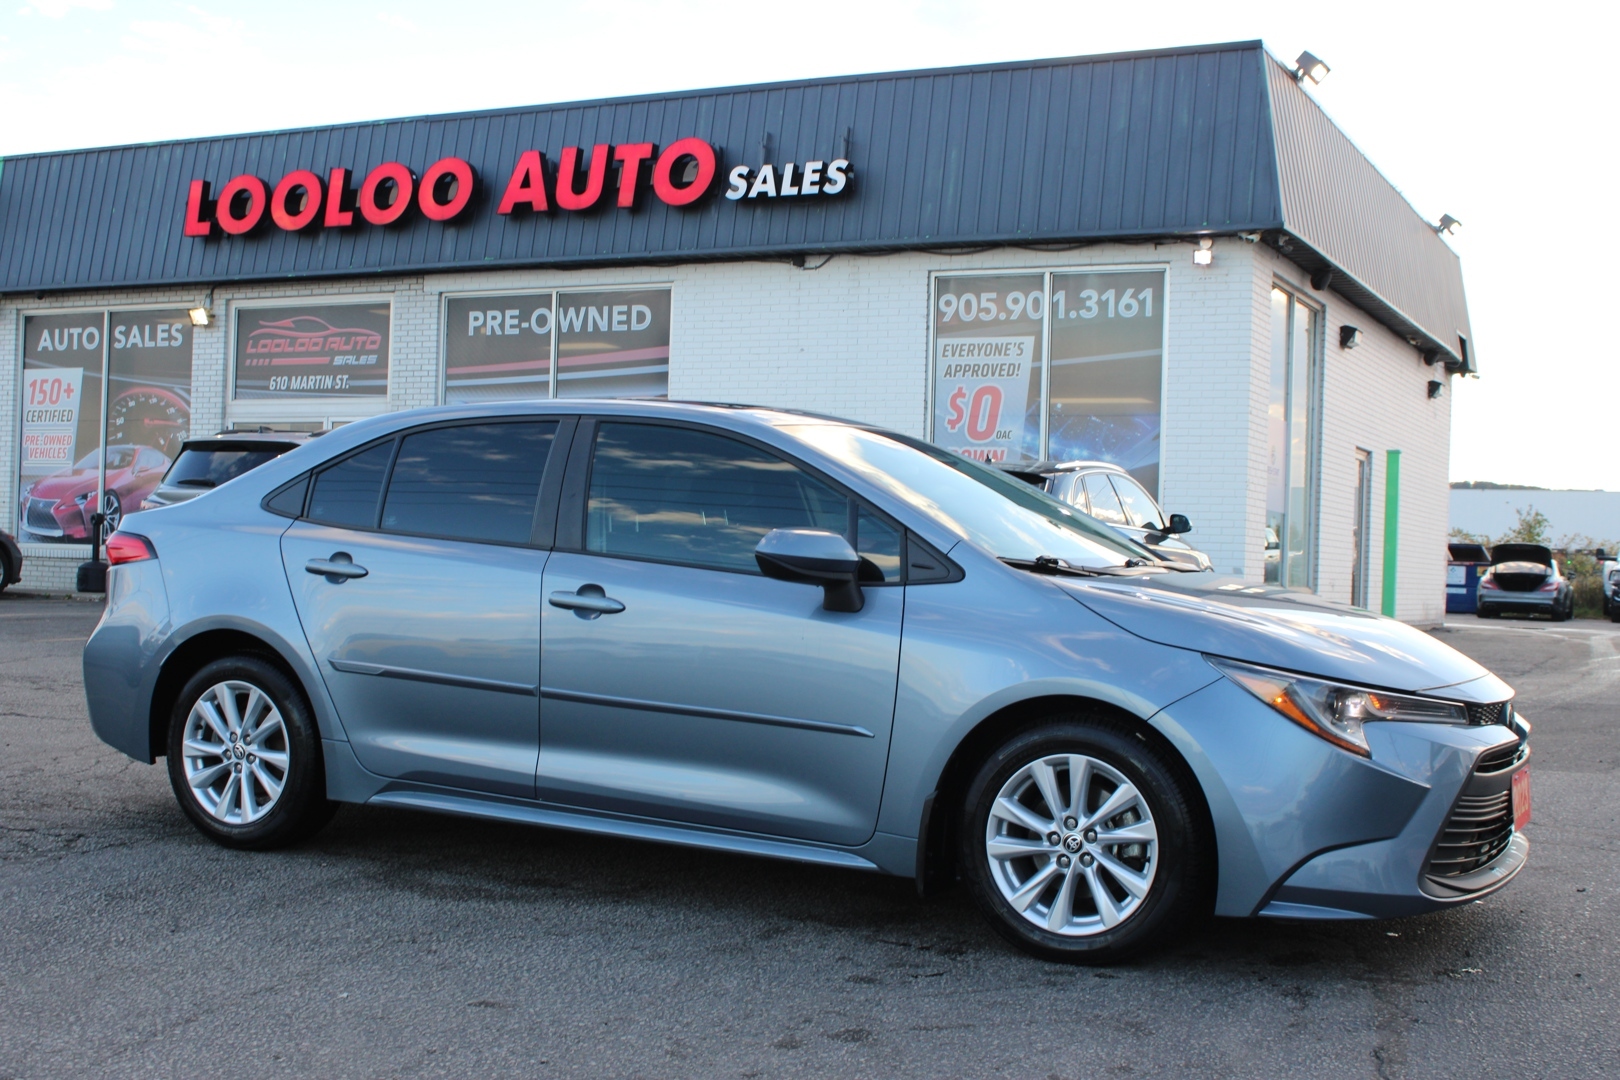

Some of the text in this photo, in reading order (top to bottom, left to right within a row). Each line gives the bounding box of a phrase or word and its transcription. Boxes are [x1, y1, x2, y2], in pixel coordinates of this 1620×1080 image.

[184, 137, 850, 237] LOOLOO AUTO SALES
[939, 288, 1153, 322] 905.901.3161
[468, 304, 652, 337] PRE-OWNED
[37, 323, 183, 352] AUTO SALES
[246, 336, 381, 354] LOOLOO AUTO
[942, 342, 1025, 358] EVERYONE'S
[333, 355, 378, 365] SALES
[943, 363, 1021, 378] APPROVED!
[269, 375, 349, 390] 610 MARTIN ST.
[29, 378, 75, 406] 150+
[25, 409, 74, 423] CERTIFIED
[947, 385, 1012, 441] $0 OAC
[24, 434, 73, 446] PRE-OWNED
[29, 447, 67, 459] VEHICLES
